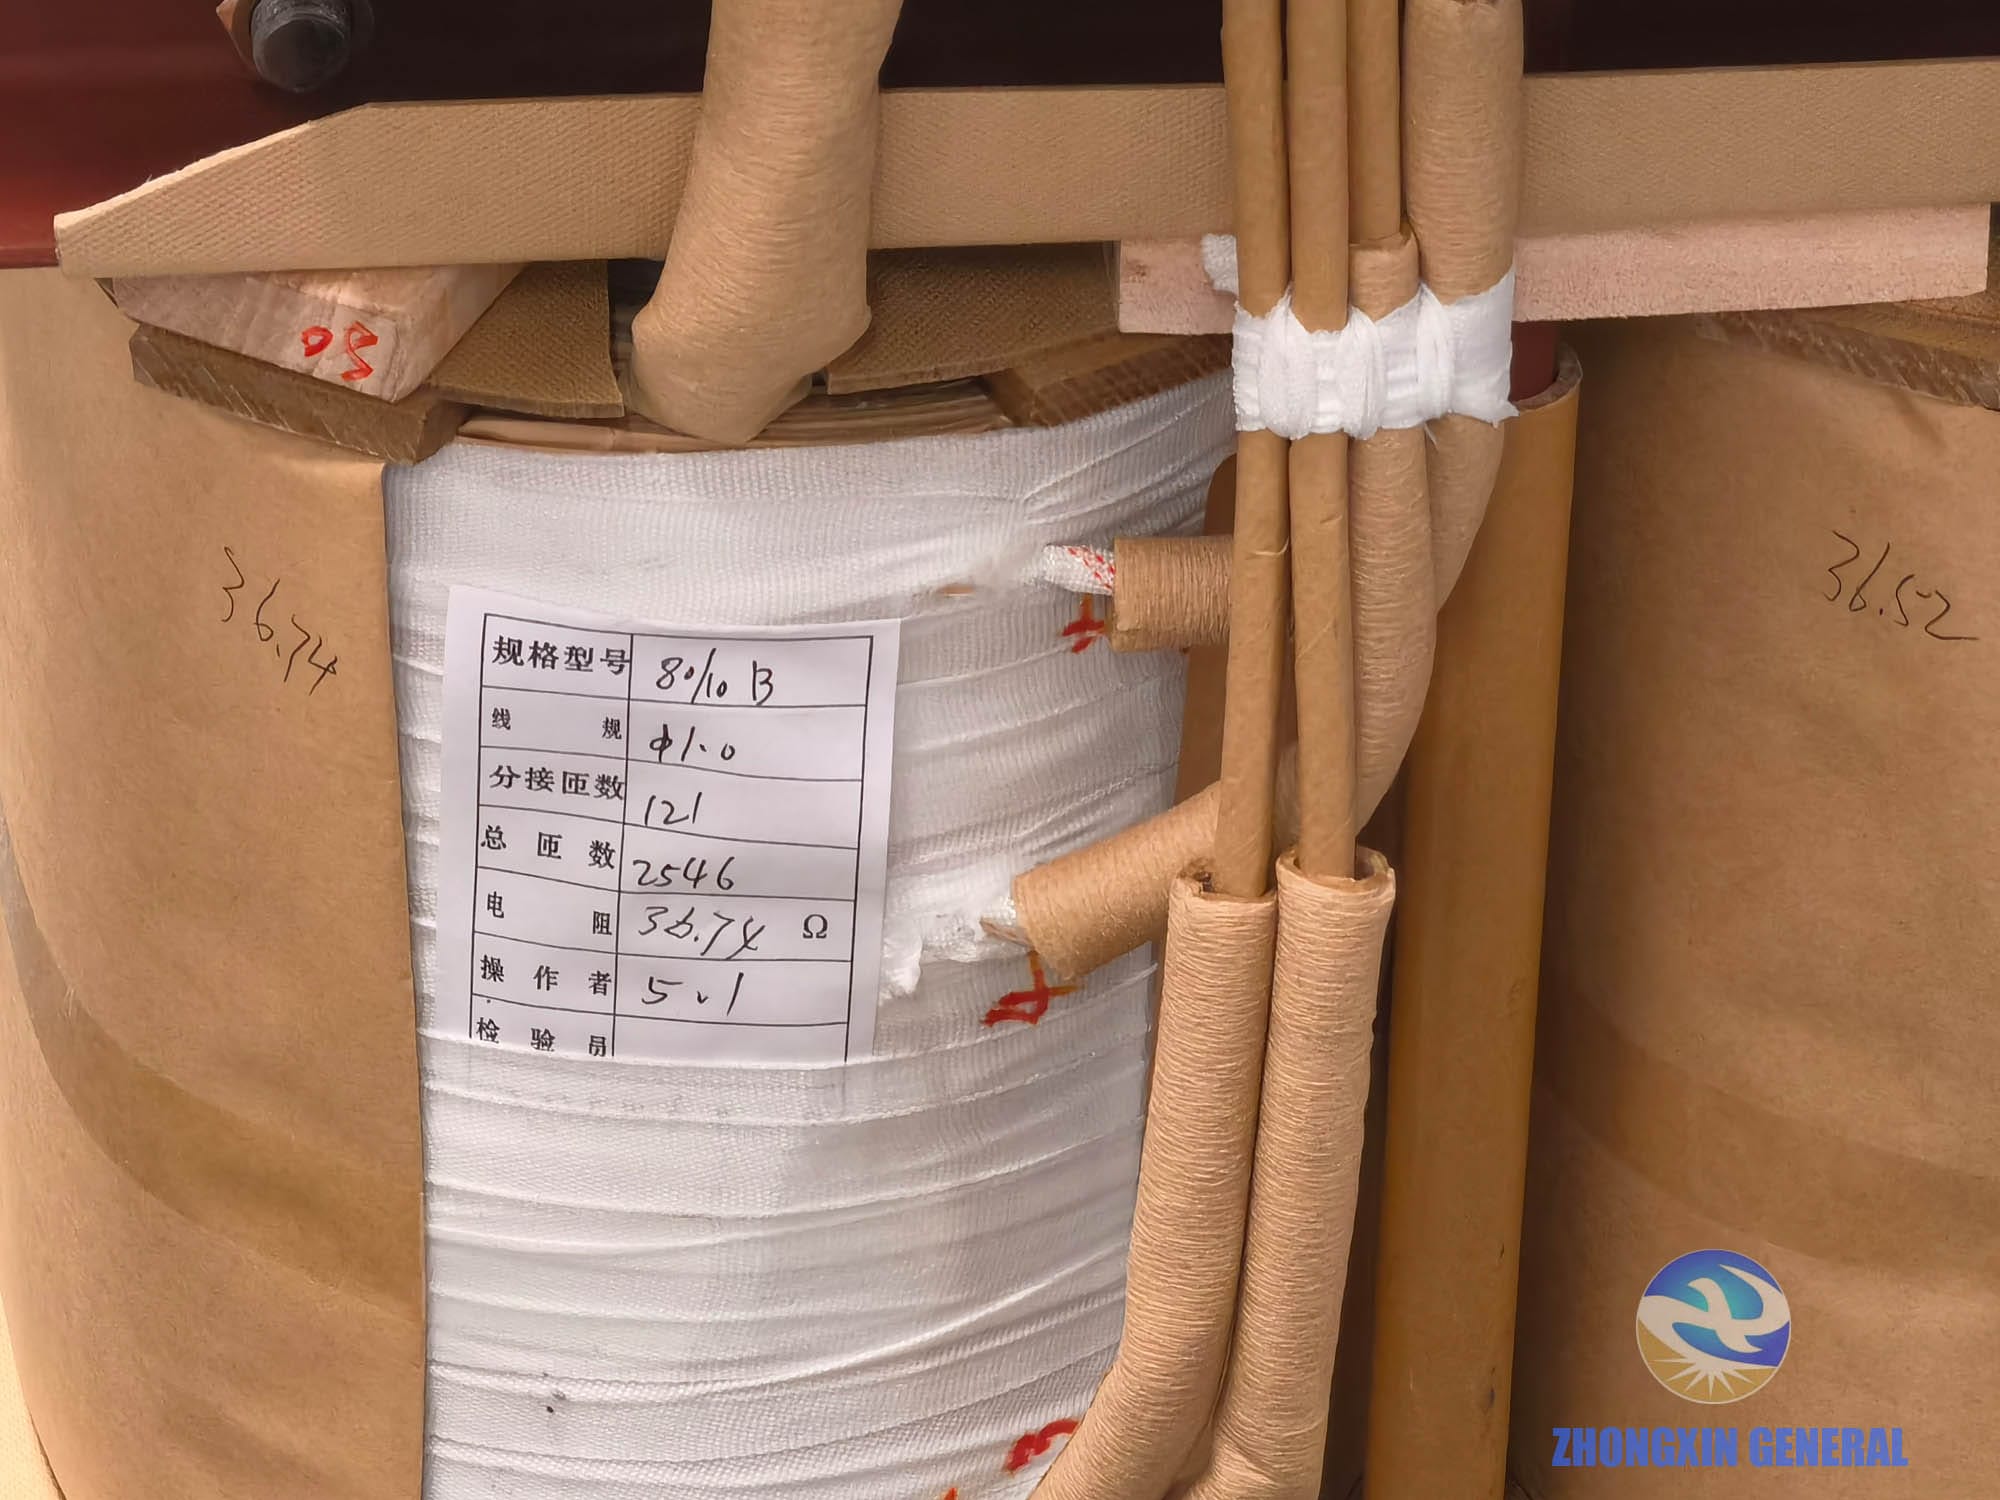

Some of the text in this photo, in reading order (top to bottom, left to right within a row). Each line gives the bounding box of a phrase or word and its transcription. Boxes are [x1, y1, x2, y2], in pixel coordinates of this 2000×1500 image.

[1823, 530, 1980, 641] 36.52
[491, 635, 630, 675] 规格型号
[752, 660, 774, 706] B
[489, 764, 626, 801] 分接匝数
[644, 792, 702, 826] 121
[632, 857, 735, 890] 2546
[638, 907, 766, 960] 36.74
[802, 914, 829, 939] Ω
